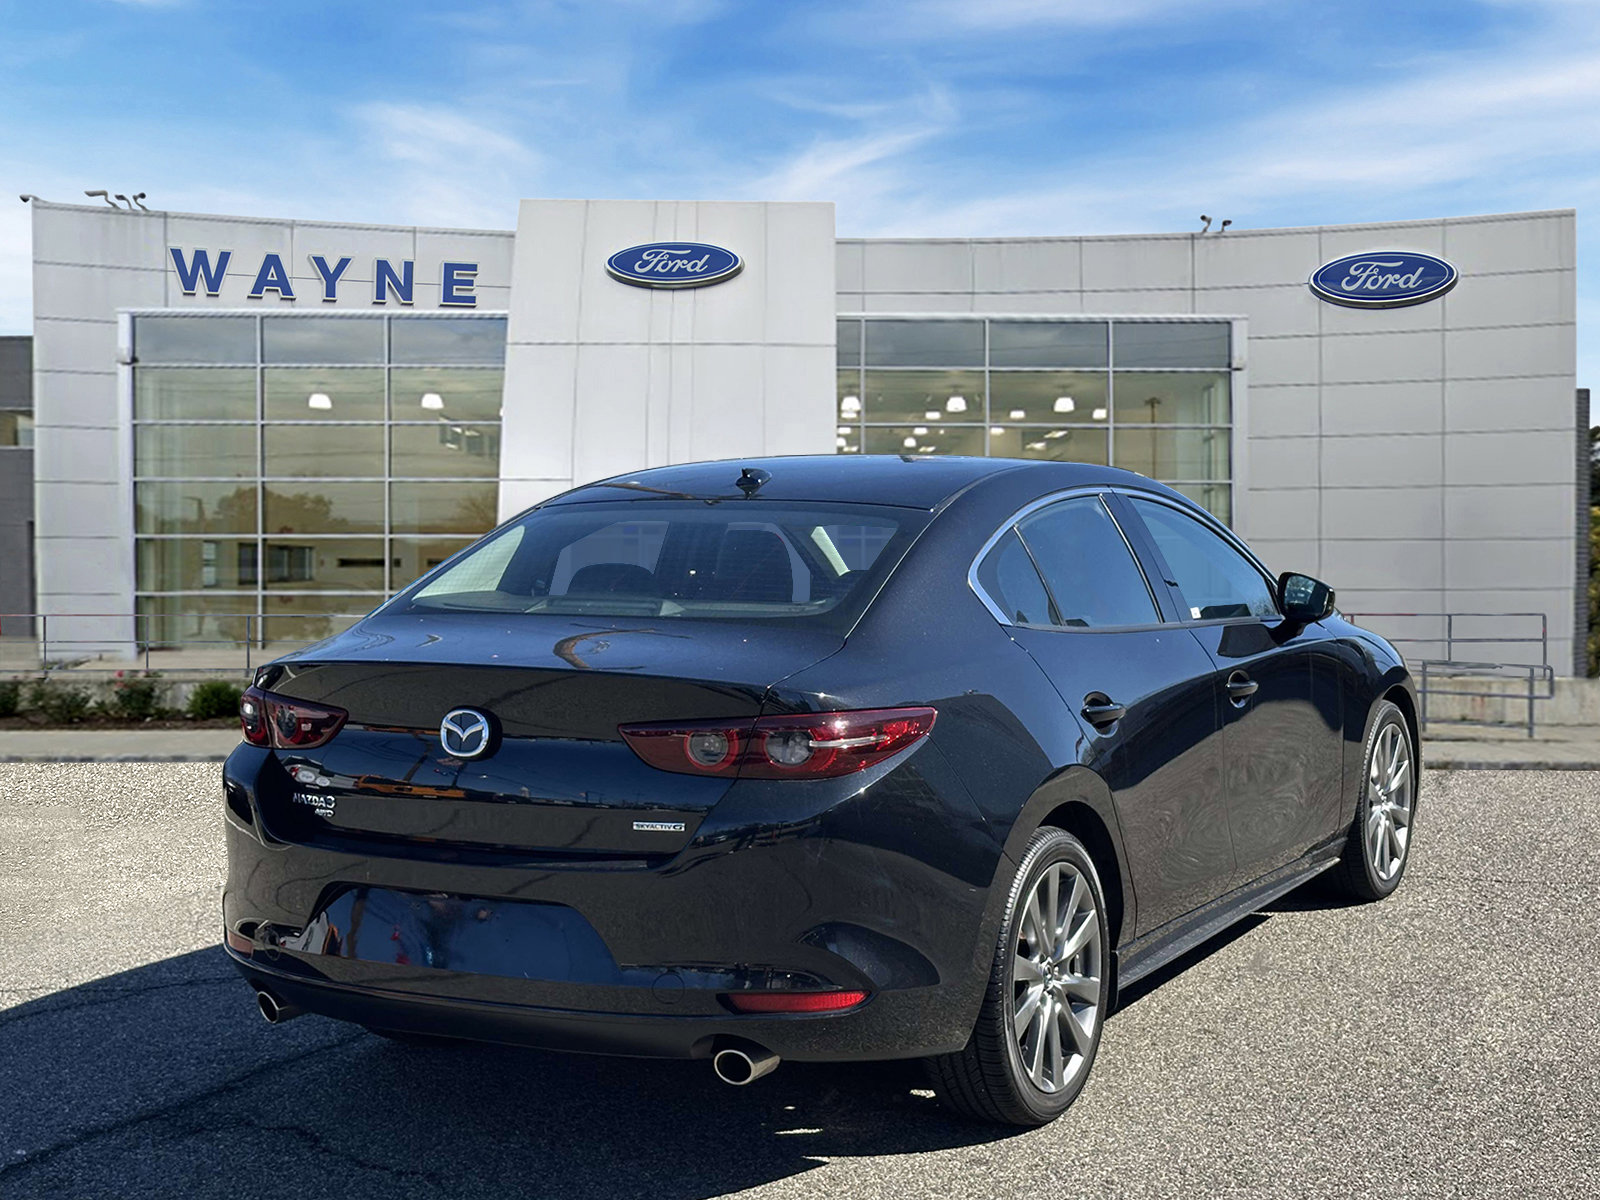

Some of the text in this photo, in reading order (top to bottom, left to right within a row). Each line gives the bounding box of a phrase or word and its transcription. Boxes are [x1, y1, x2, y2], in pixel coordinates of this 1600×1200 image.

[634, 249, 711, 273] Ford
[1341, 261, 1425, 291] Ford
[169, 246, 479, 307] WAYNE
